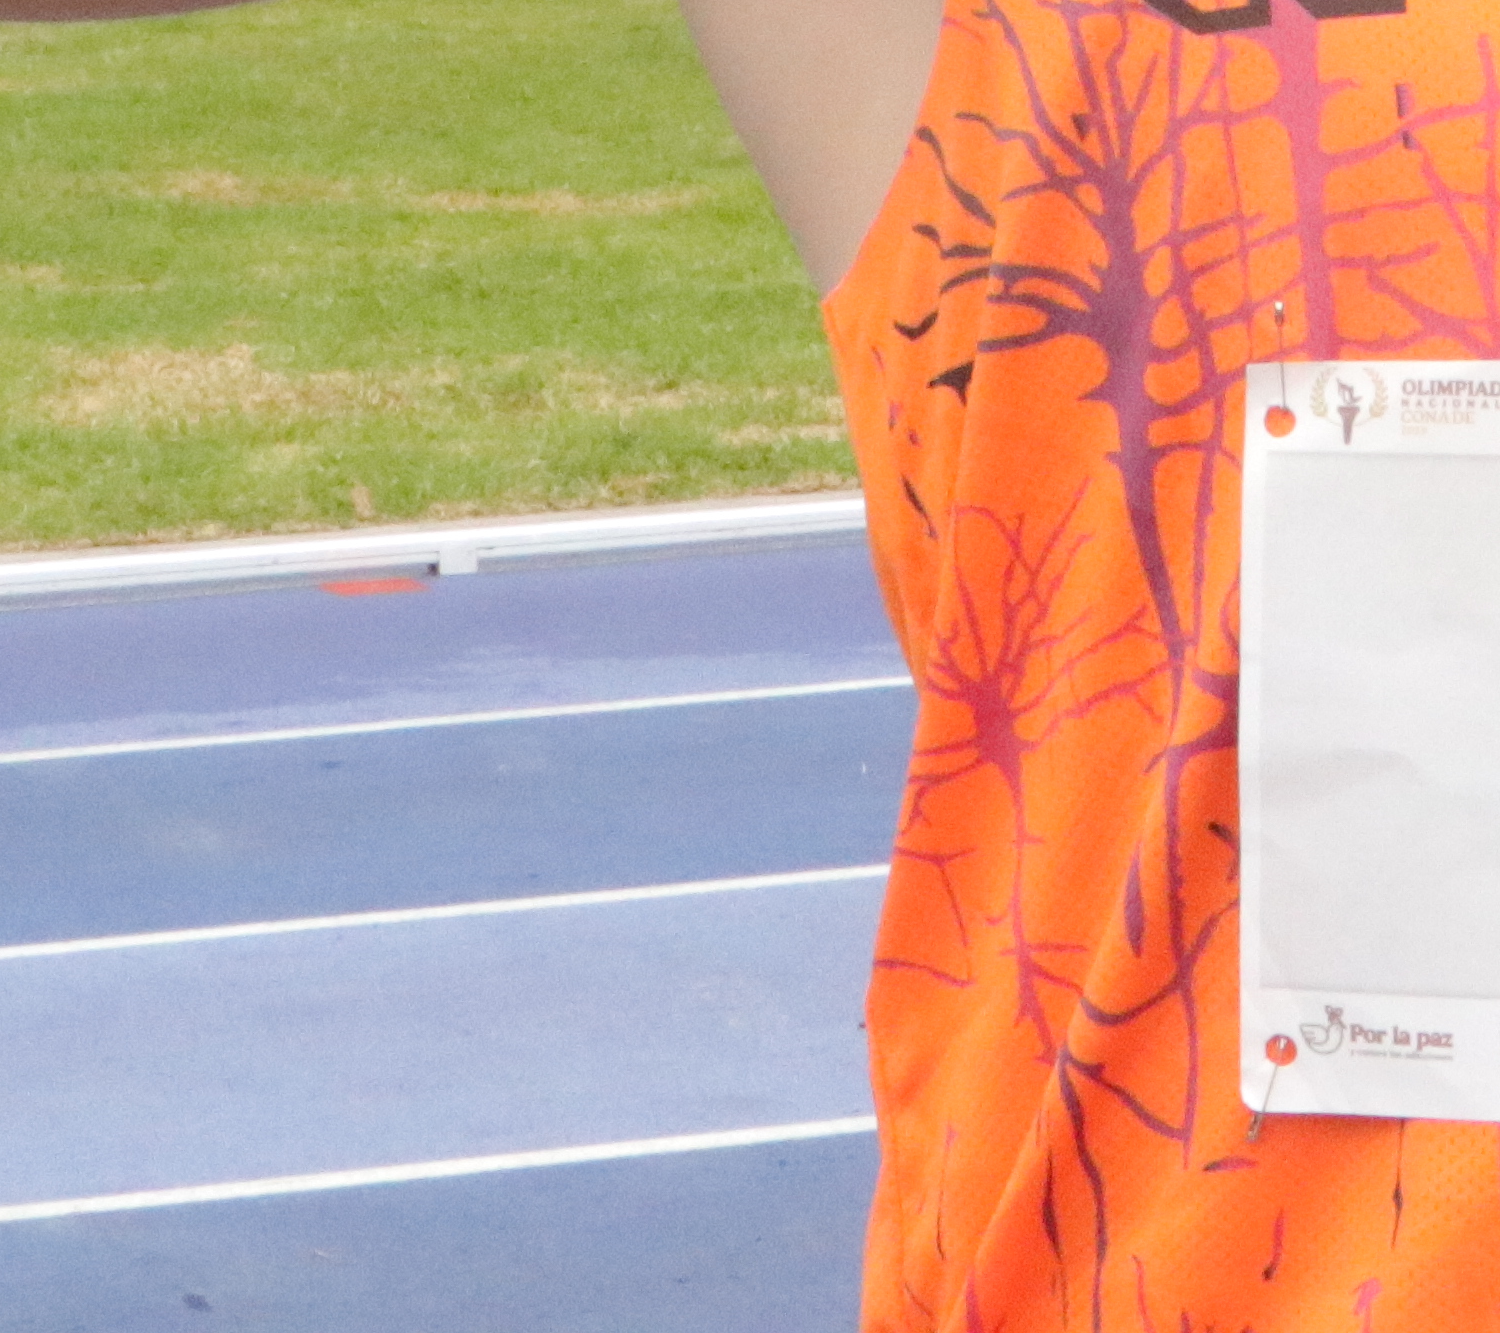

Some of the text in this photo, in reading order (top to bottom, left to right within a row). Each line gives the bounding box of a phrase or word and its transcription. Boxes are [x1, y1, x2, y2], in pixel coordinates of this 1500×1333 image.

[1400, 411, 1475, 425] CONADE
[1350, 1024, 1454, 1052] Por la paz
